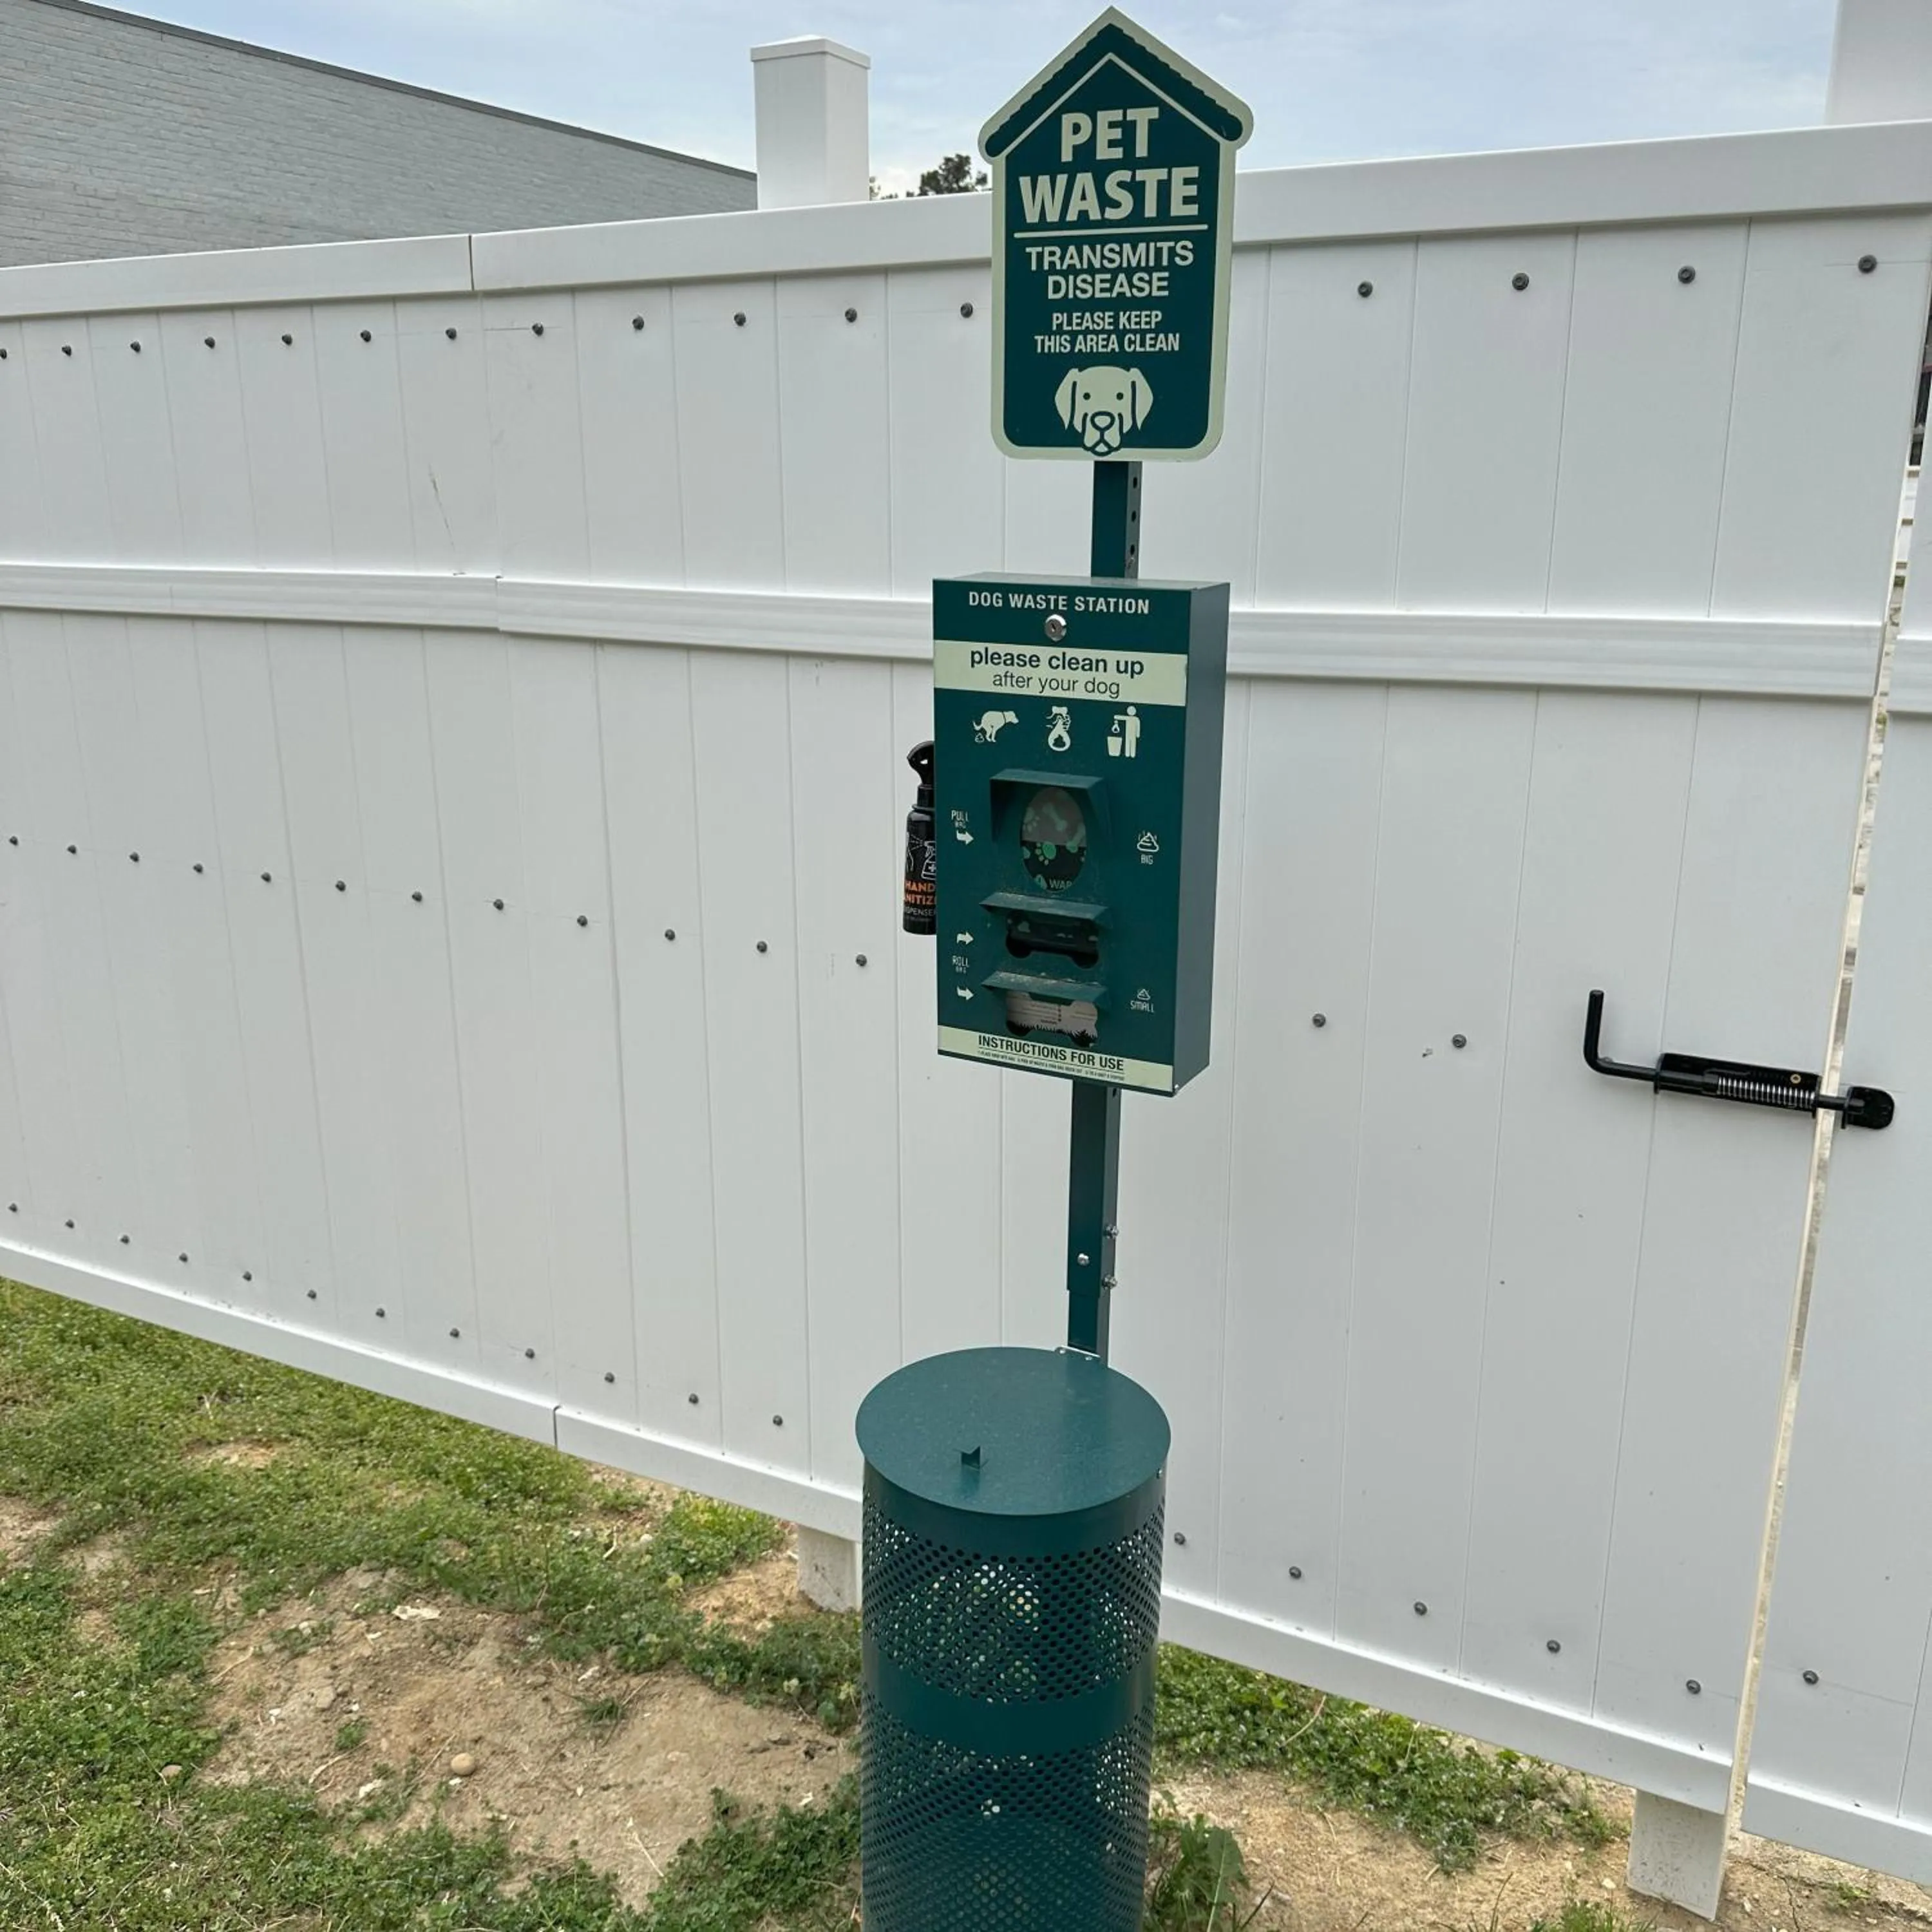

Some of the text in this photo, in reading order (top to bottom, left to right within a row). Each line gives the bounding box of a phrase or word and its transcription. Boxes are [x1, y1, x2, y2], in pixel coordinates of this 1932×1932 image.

[1061, 106, 1159, 162] PET
[1019, 166, 1199, 223] WASTE
[1025, 240, 1194, 271] TRANSMITS
[1048, 272, 1170, 299] DISEASE
[1052, 310, 1162, 331] PLEASE KEEP
[1034, 332, 1180, 354] THIS AREA CLEAN
[969, 591, 1150, 614] DOG WASTE STATION
[971, 647, 1144, 679] please clean up
[992, 670, 1120, 699] after your dog
[1141, 854, 1153, 865] BIG
[904, 880, 936, 892] HAND
[904, 893, 936, 905] NITIZ
[978, 1034, 1067, 1061] INSTRUCTIONS
[1071, 1050, 1095, 1066] FOR
[1099, 1056, 1124, 1070] USE
